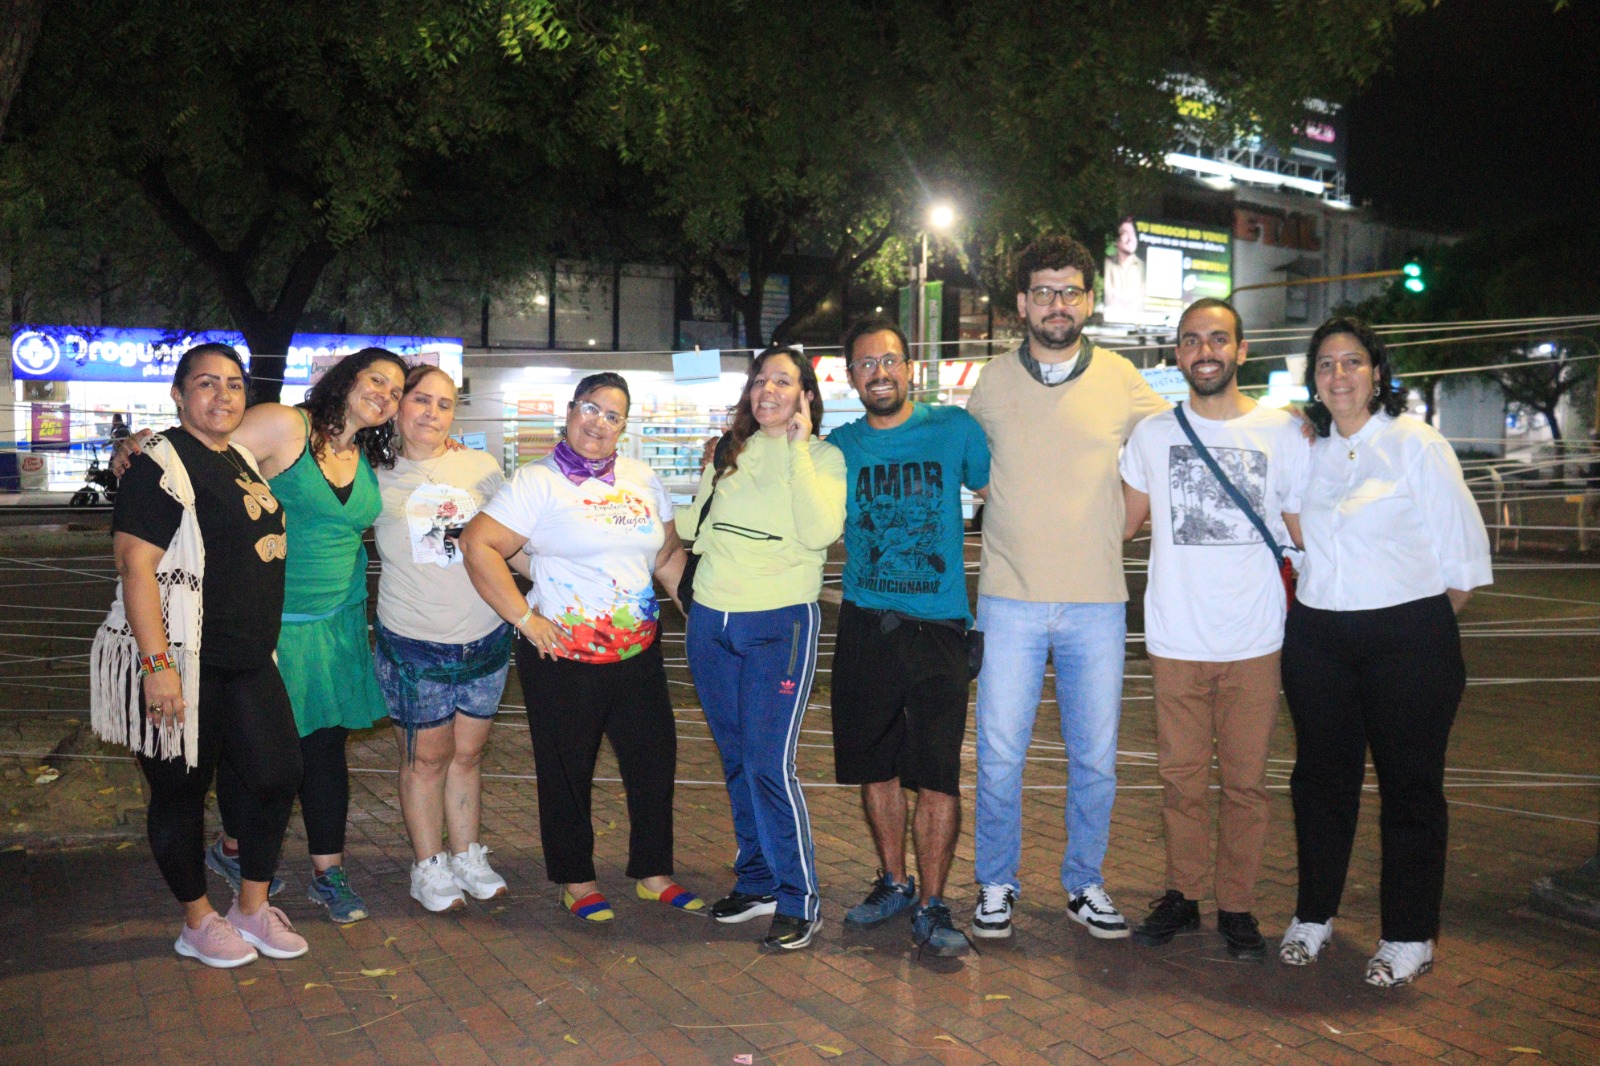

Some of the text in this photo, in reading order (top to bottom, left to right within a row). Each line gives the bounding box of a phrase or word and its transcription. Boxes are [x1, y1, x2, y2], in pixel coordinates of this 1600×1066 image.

[1150, 224, 1188, 238] NEGOCIO
[855, 461, 944, 503] AMOR
[612, 515, 647, 528] Mujer
